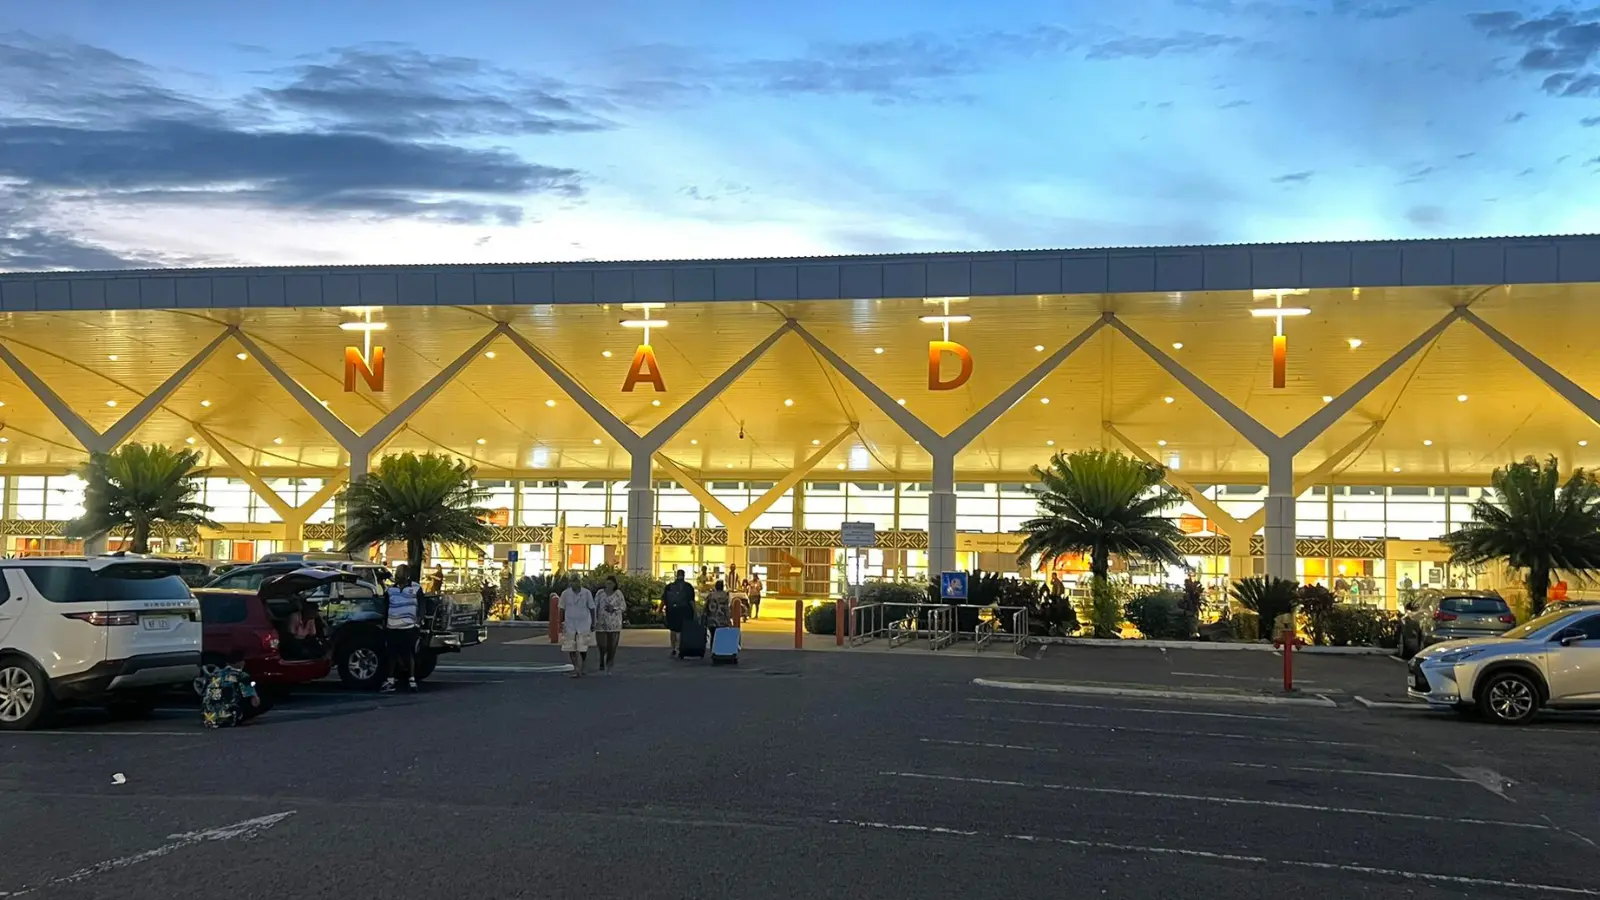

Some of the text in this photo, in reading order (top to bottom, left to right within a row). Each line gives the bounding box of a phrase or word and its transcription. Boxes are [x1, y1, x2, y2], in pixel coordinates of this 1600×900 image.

[344, 346, 385, 392] N
[621, 344, 667, 392] A
[928, 340, 973, 390] D
